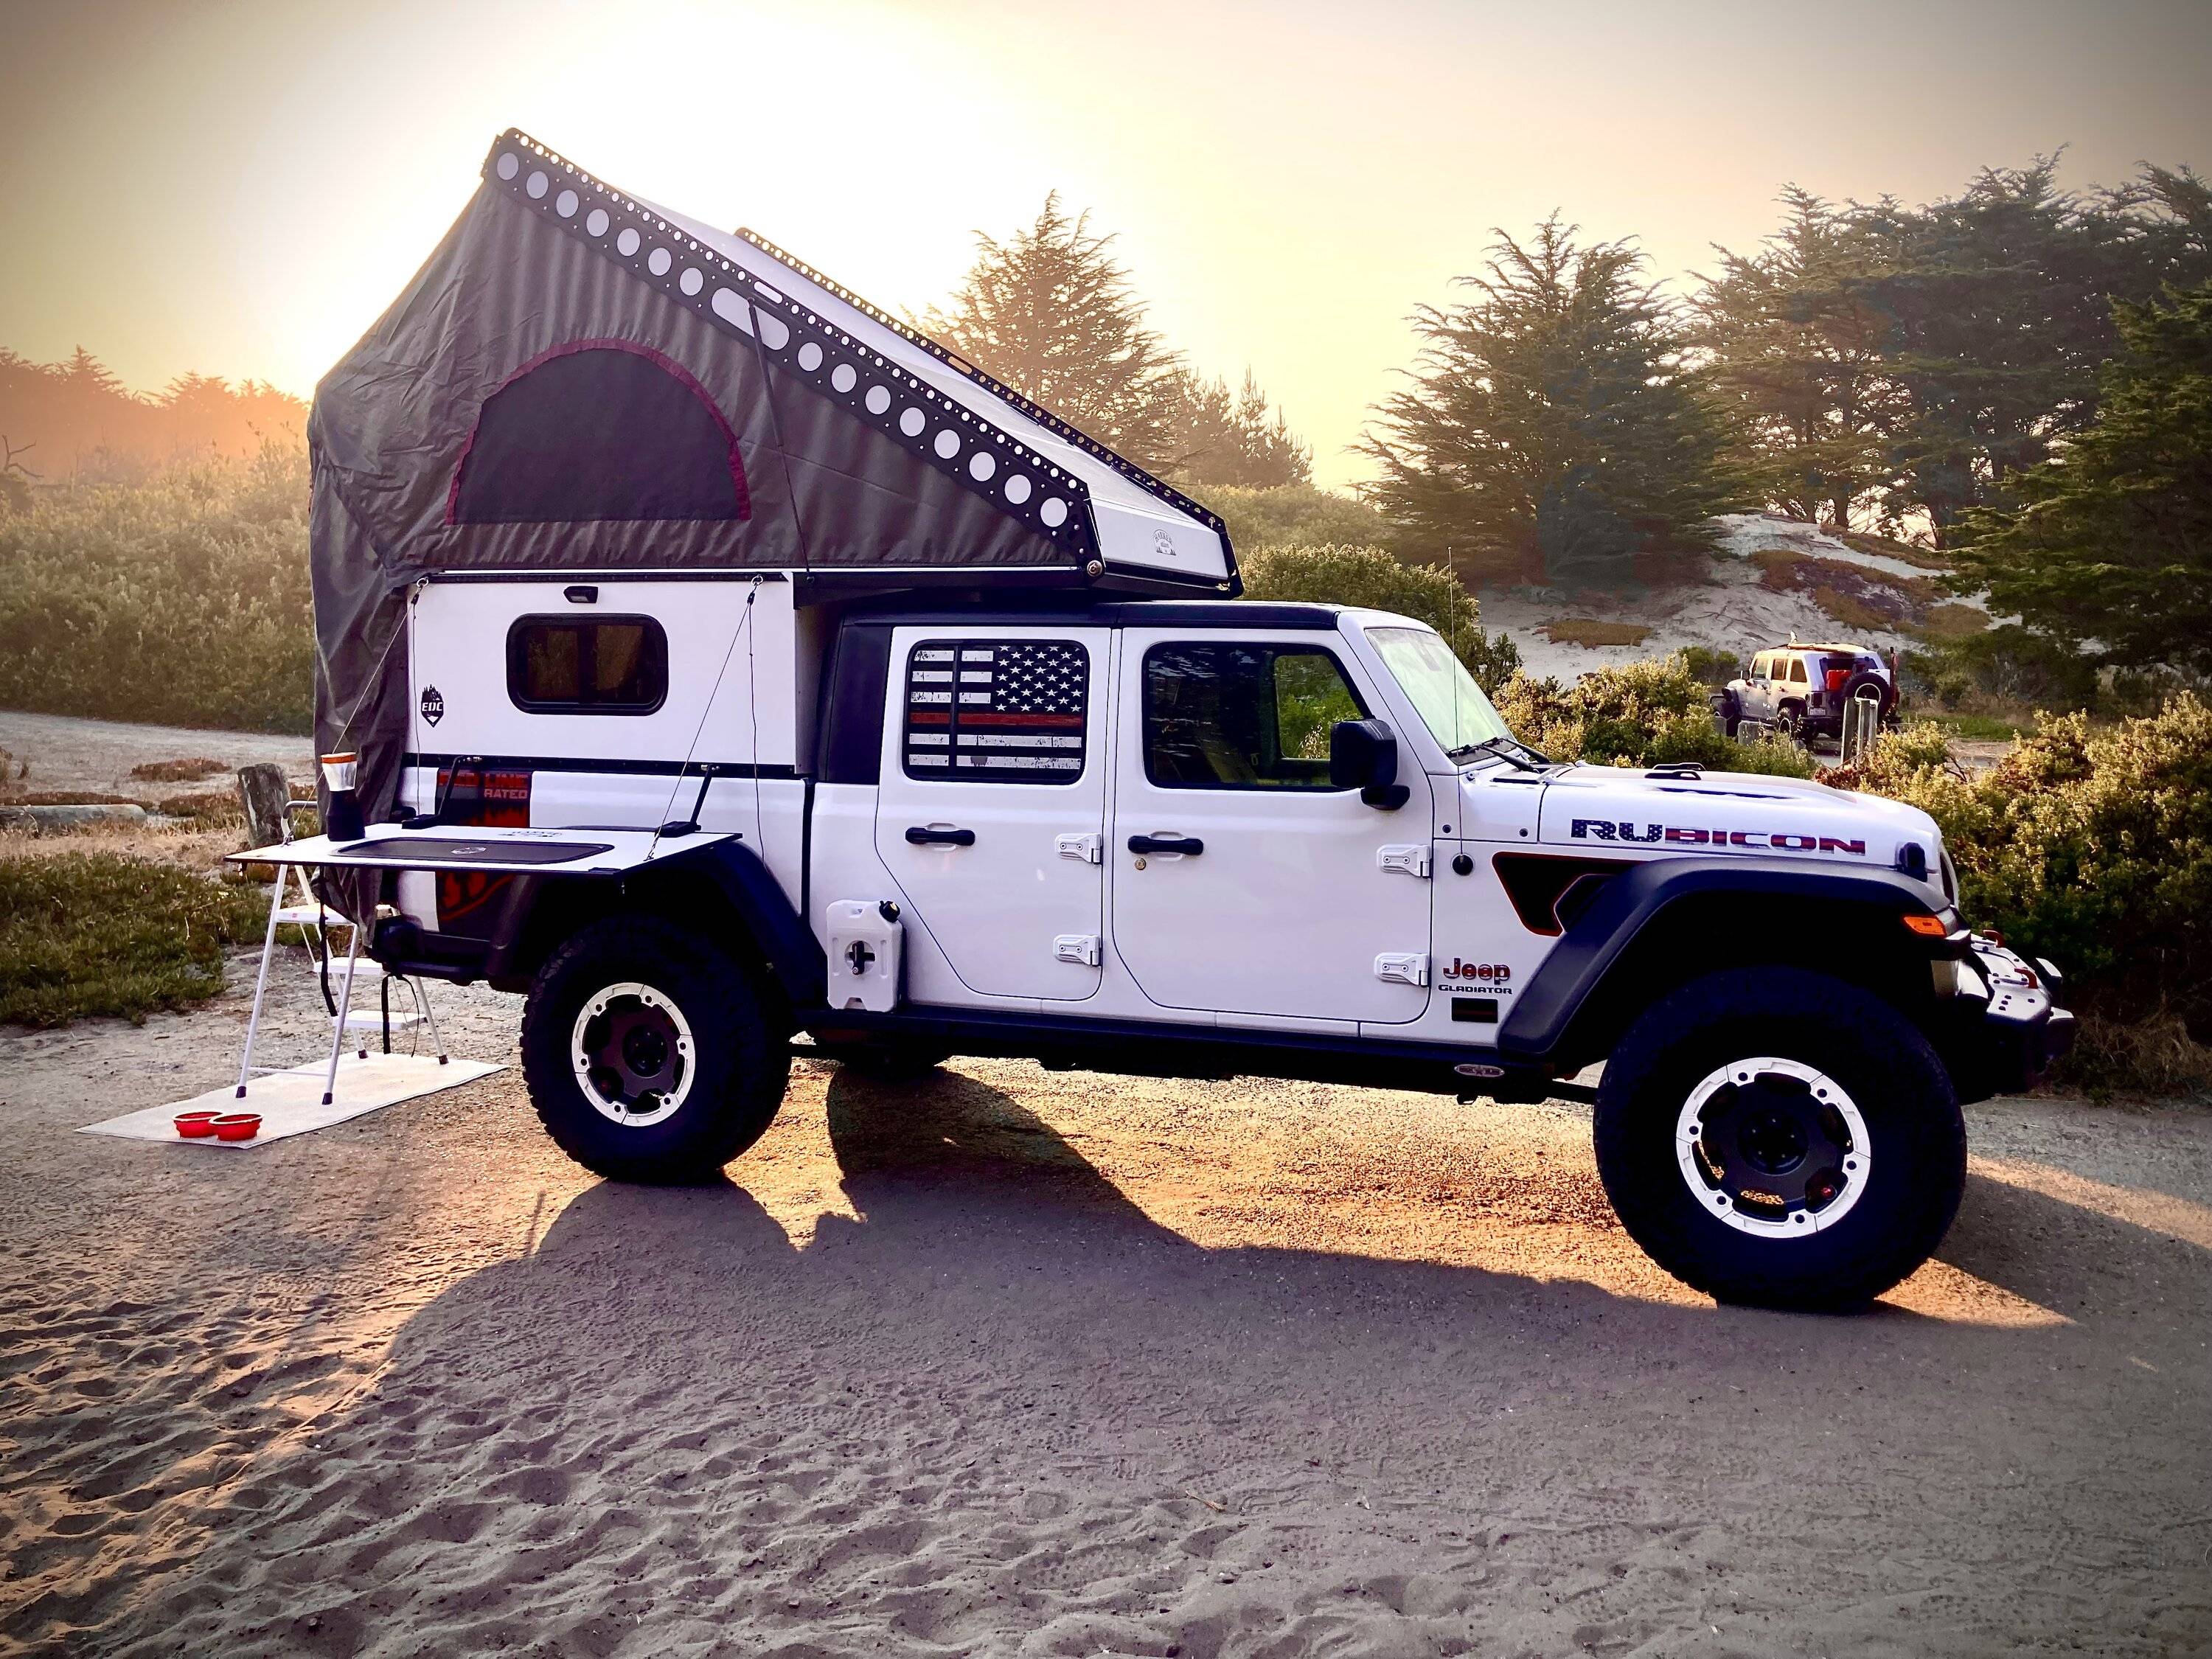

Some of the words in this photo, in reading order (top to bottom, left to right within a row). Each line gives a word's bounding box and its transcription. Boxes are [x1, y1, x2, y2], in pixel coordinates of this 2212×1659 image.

[422, 702, 443, 712] EDC
[484, 788, 528, 799] RATED
[1571, 818, 1866, 857] RUBICON
[1443, 957, 1511, 986] Jeep
[1438, 984, 1513, 995] GLADIATOR
